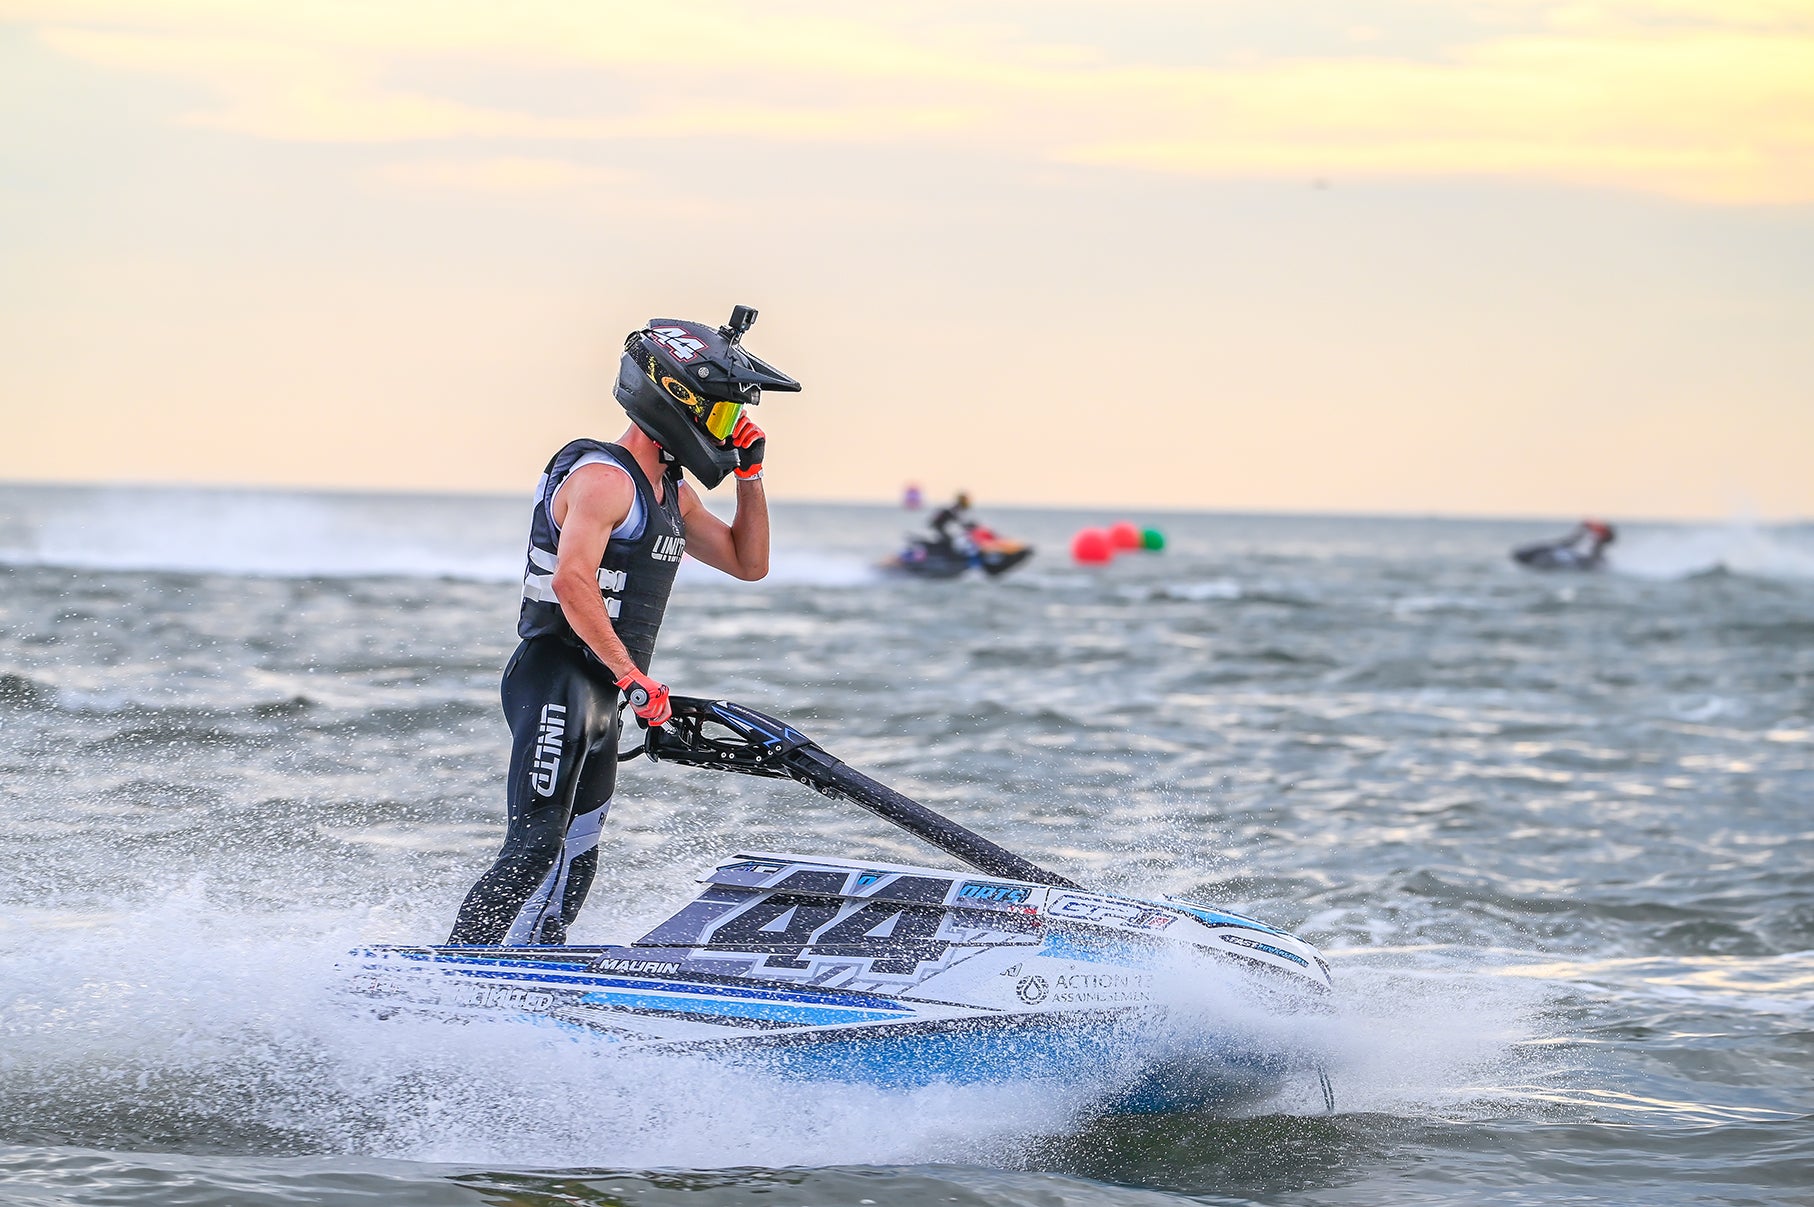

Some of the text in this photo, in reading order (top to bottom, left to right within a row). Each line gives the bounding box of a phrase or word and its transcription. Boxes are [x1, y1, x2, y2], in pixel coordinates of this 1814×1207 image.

[652, 327, 706, 361] 44
[704, 869, 955, 976] 44
[599, 959, 680, 974] MAURIN
[1055, 974, 1128, 989] ACTION
